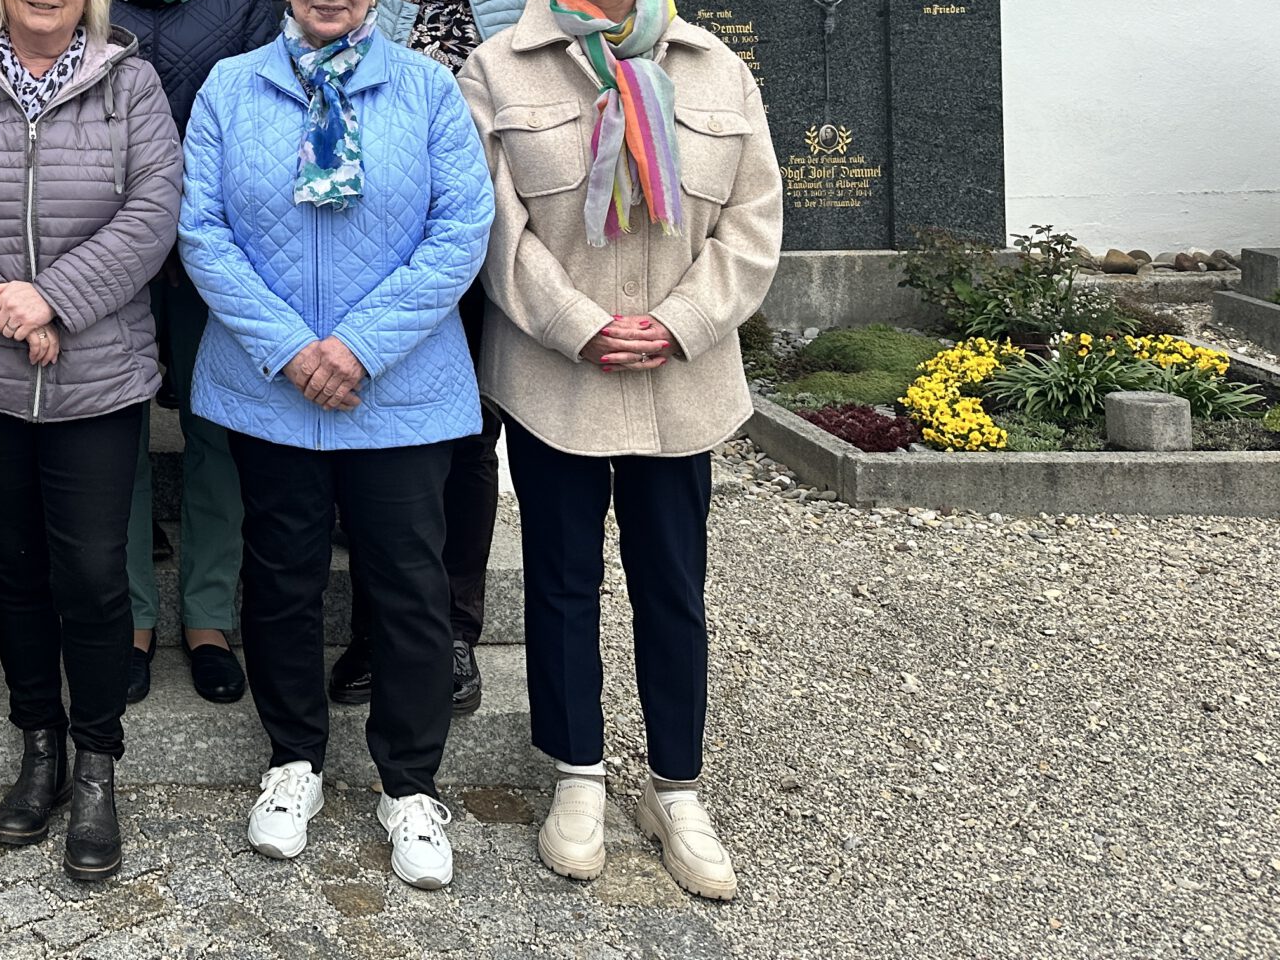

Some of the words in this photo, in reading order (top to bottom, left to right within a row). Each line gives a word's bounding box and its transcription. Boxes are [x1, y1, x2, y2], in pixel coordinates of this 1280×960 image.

[696, 9, 714, 20] Hier
[716, 10, 733, 18] ruht
[923, 5, 932, 14] in
[932, 4, 966, 15] Frieden
[710, 21, 754, 34] Demmel
[737, 46, 755, 60] mel
[807, 155, 818, 164] der
[848, 154, 865, 164] ruht
[808, 166, 838, 179] Josef
[840, 165, 882, 178] Demmel
[787, 180, 822, 190] Landwirt
[835, 179, 869, 189] Alberzell
[804, 198, 817, 208] der
[819, 198, 861, 208] Normandie
